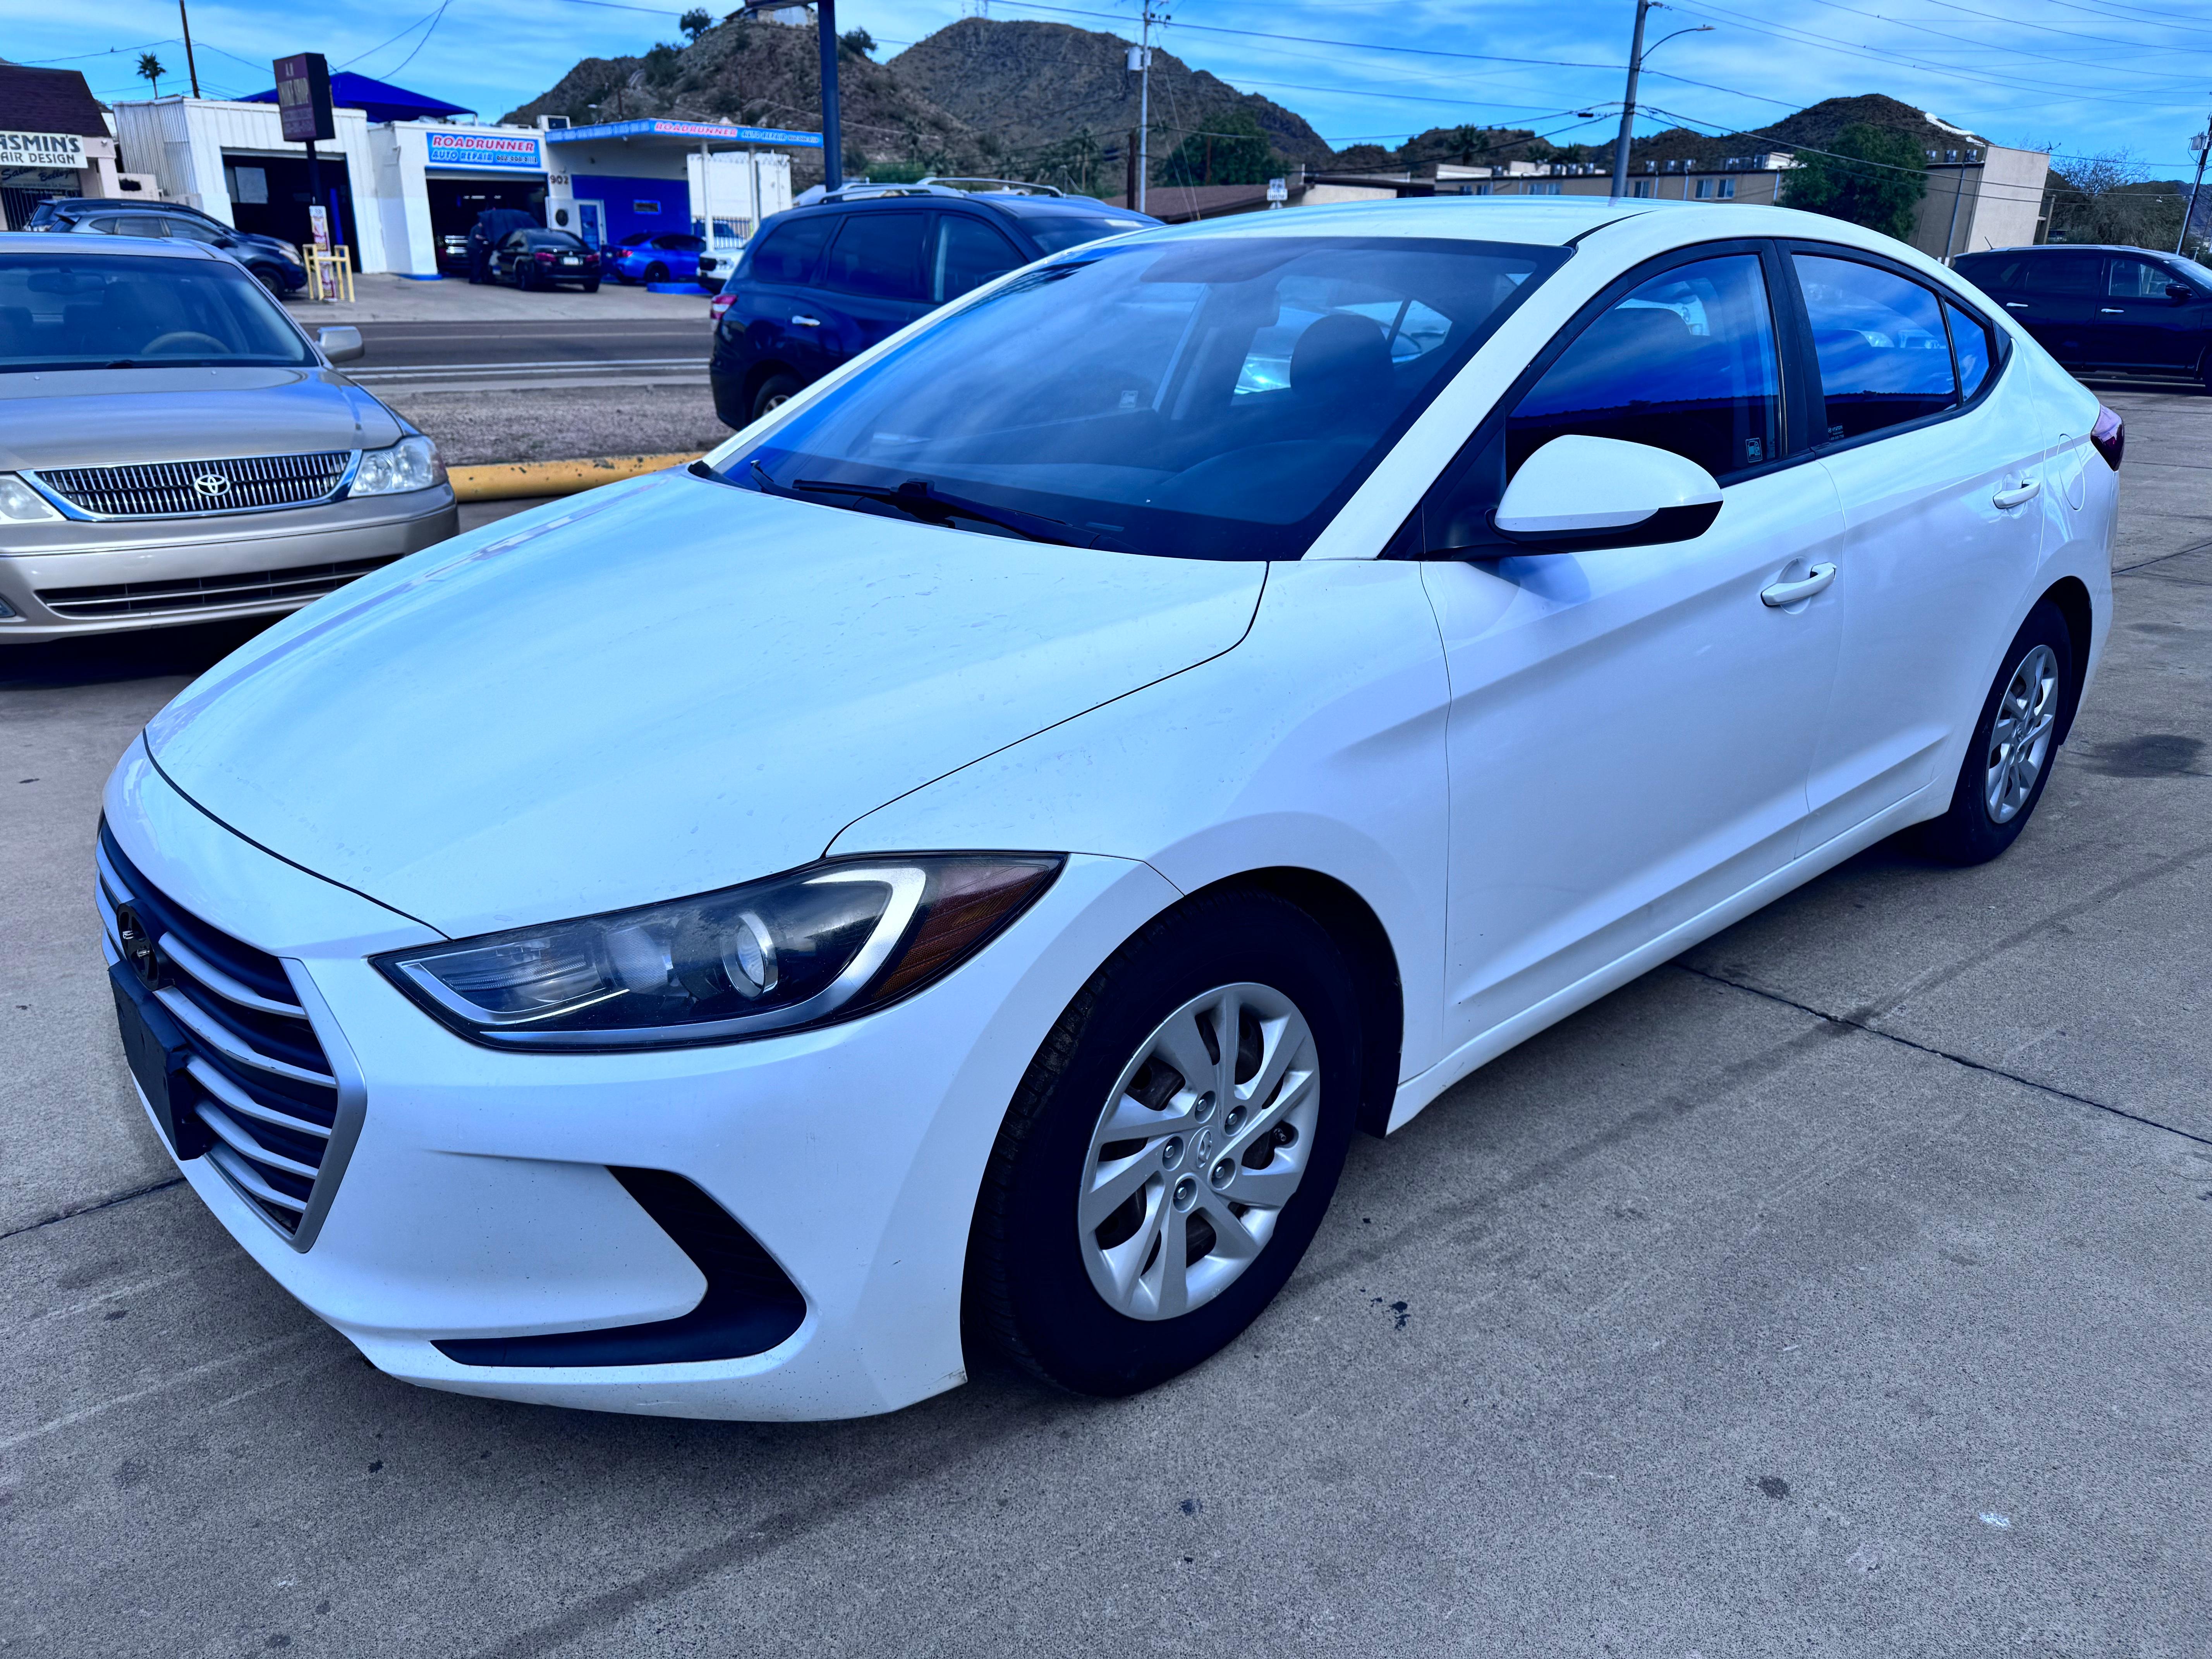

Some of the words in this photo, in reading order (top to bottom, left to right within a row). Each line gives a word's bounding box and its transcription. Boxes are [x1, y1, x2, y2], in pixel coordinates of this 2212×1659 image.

[654, 122, 737, 137] ROADRUNNER
[432, 136, 535, 152] ROADRUNNER
[28, 153, 75, 164] DESIGN
[431, 149, 459, 161] AUTO
[460, 151, 493, 162] REPAIR
[550, 174, 569, 185] 902
